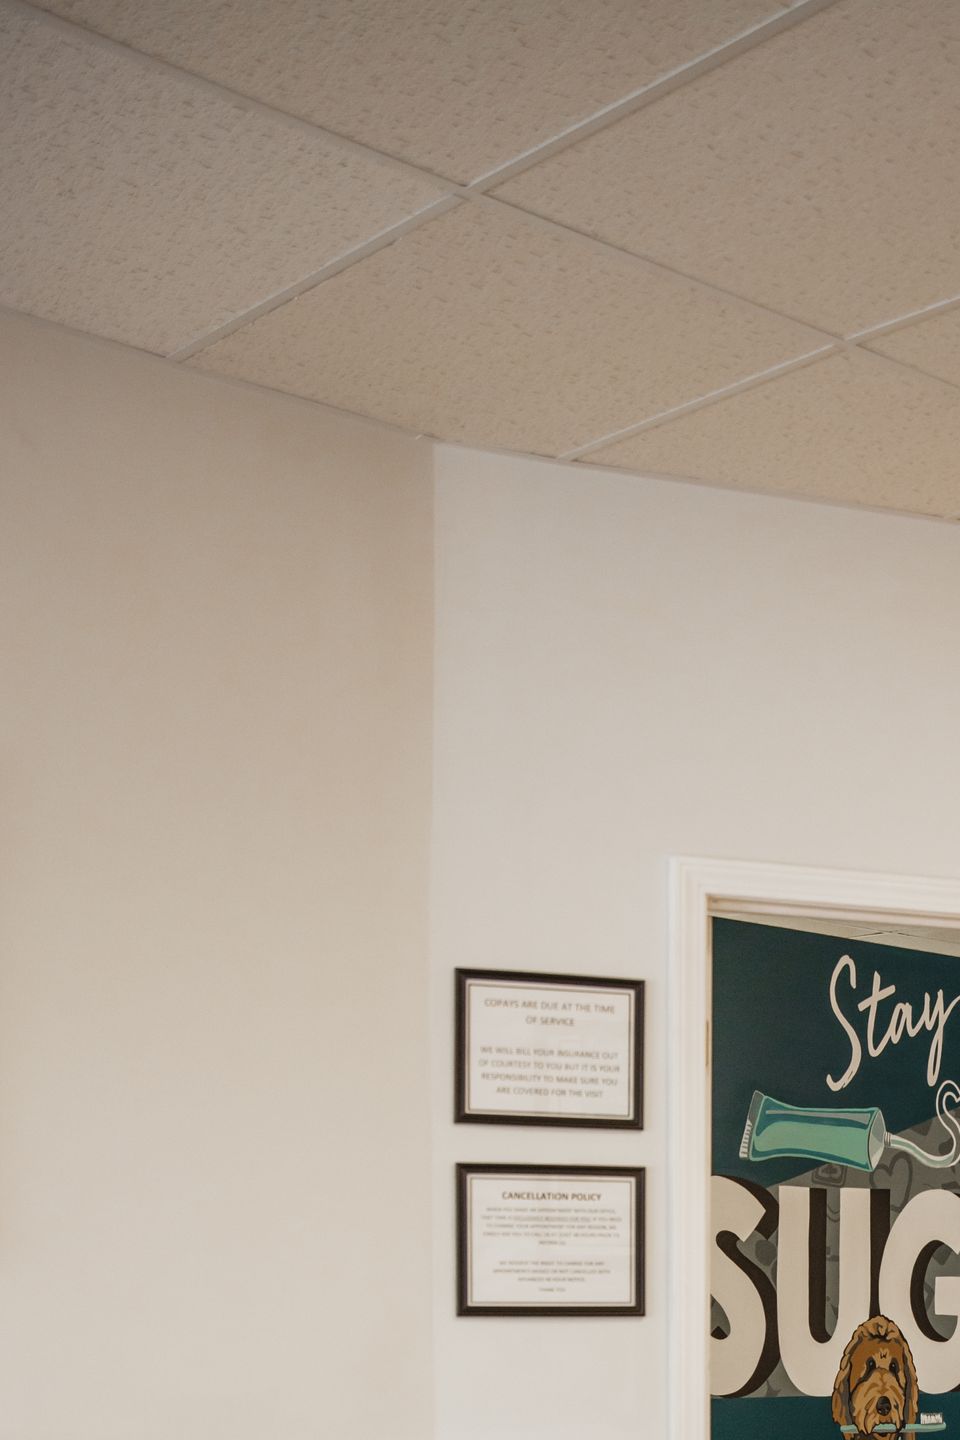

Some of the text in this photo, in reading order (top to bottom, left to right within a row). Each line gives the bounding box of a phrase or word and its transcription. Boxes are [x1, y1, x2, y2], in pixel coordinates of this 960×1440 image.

[485, 998, 615, 1014] COPAYS ARE DUE AT THE TIME
[525, 1016, 574, 1026] OF SERVICE
[826, 954, 953, 1092] Stay
[516, 1048, 530, 1056] BILL
[533, 1049, 554, 1057] YOUR
[557, 1050, 600, 1059] INSURANCE
[602, 1051, 618, 1060] OUT
[479, 1059, 620, 1072] OF COURTESY TO YOU BUT IT IS YOUR
[481, 1072, 617, 1086] RESPONSIBILITY TO MAKE SURE YOU
[496, 1086, 510, 1095] ARE
[513, 1087, 549, 1096] COVERED
[552, 1089, 566, 1097] FOR
[569, 1089, 582, 1098] THE
[502, 1191, 601, 1201] CANCELLATION POLICY
